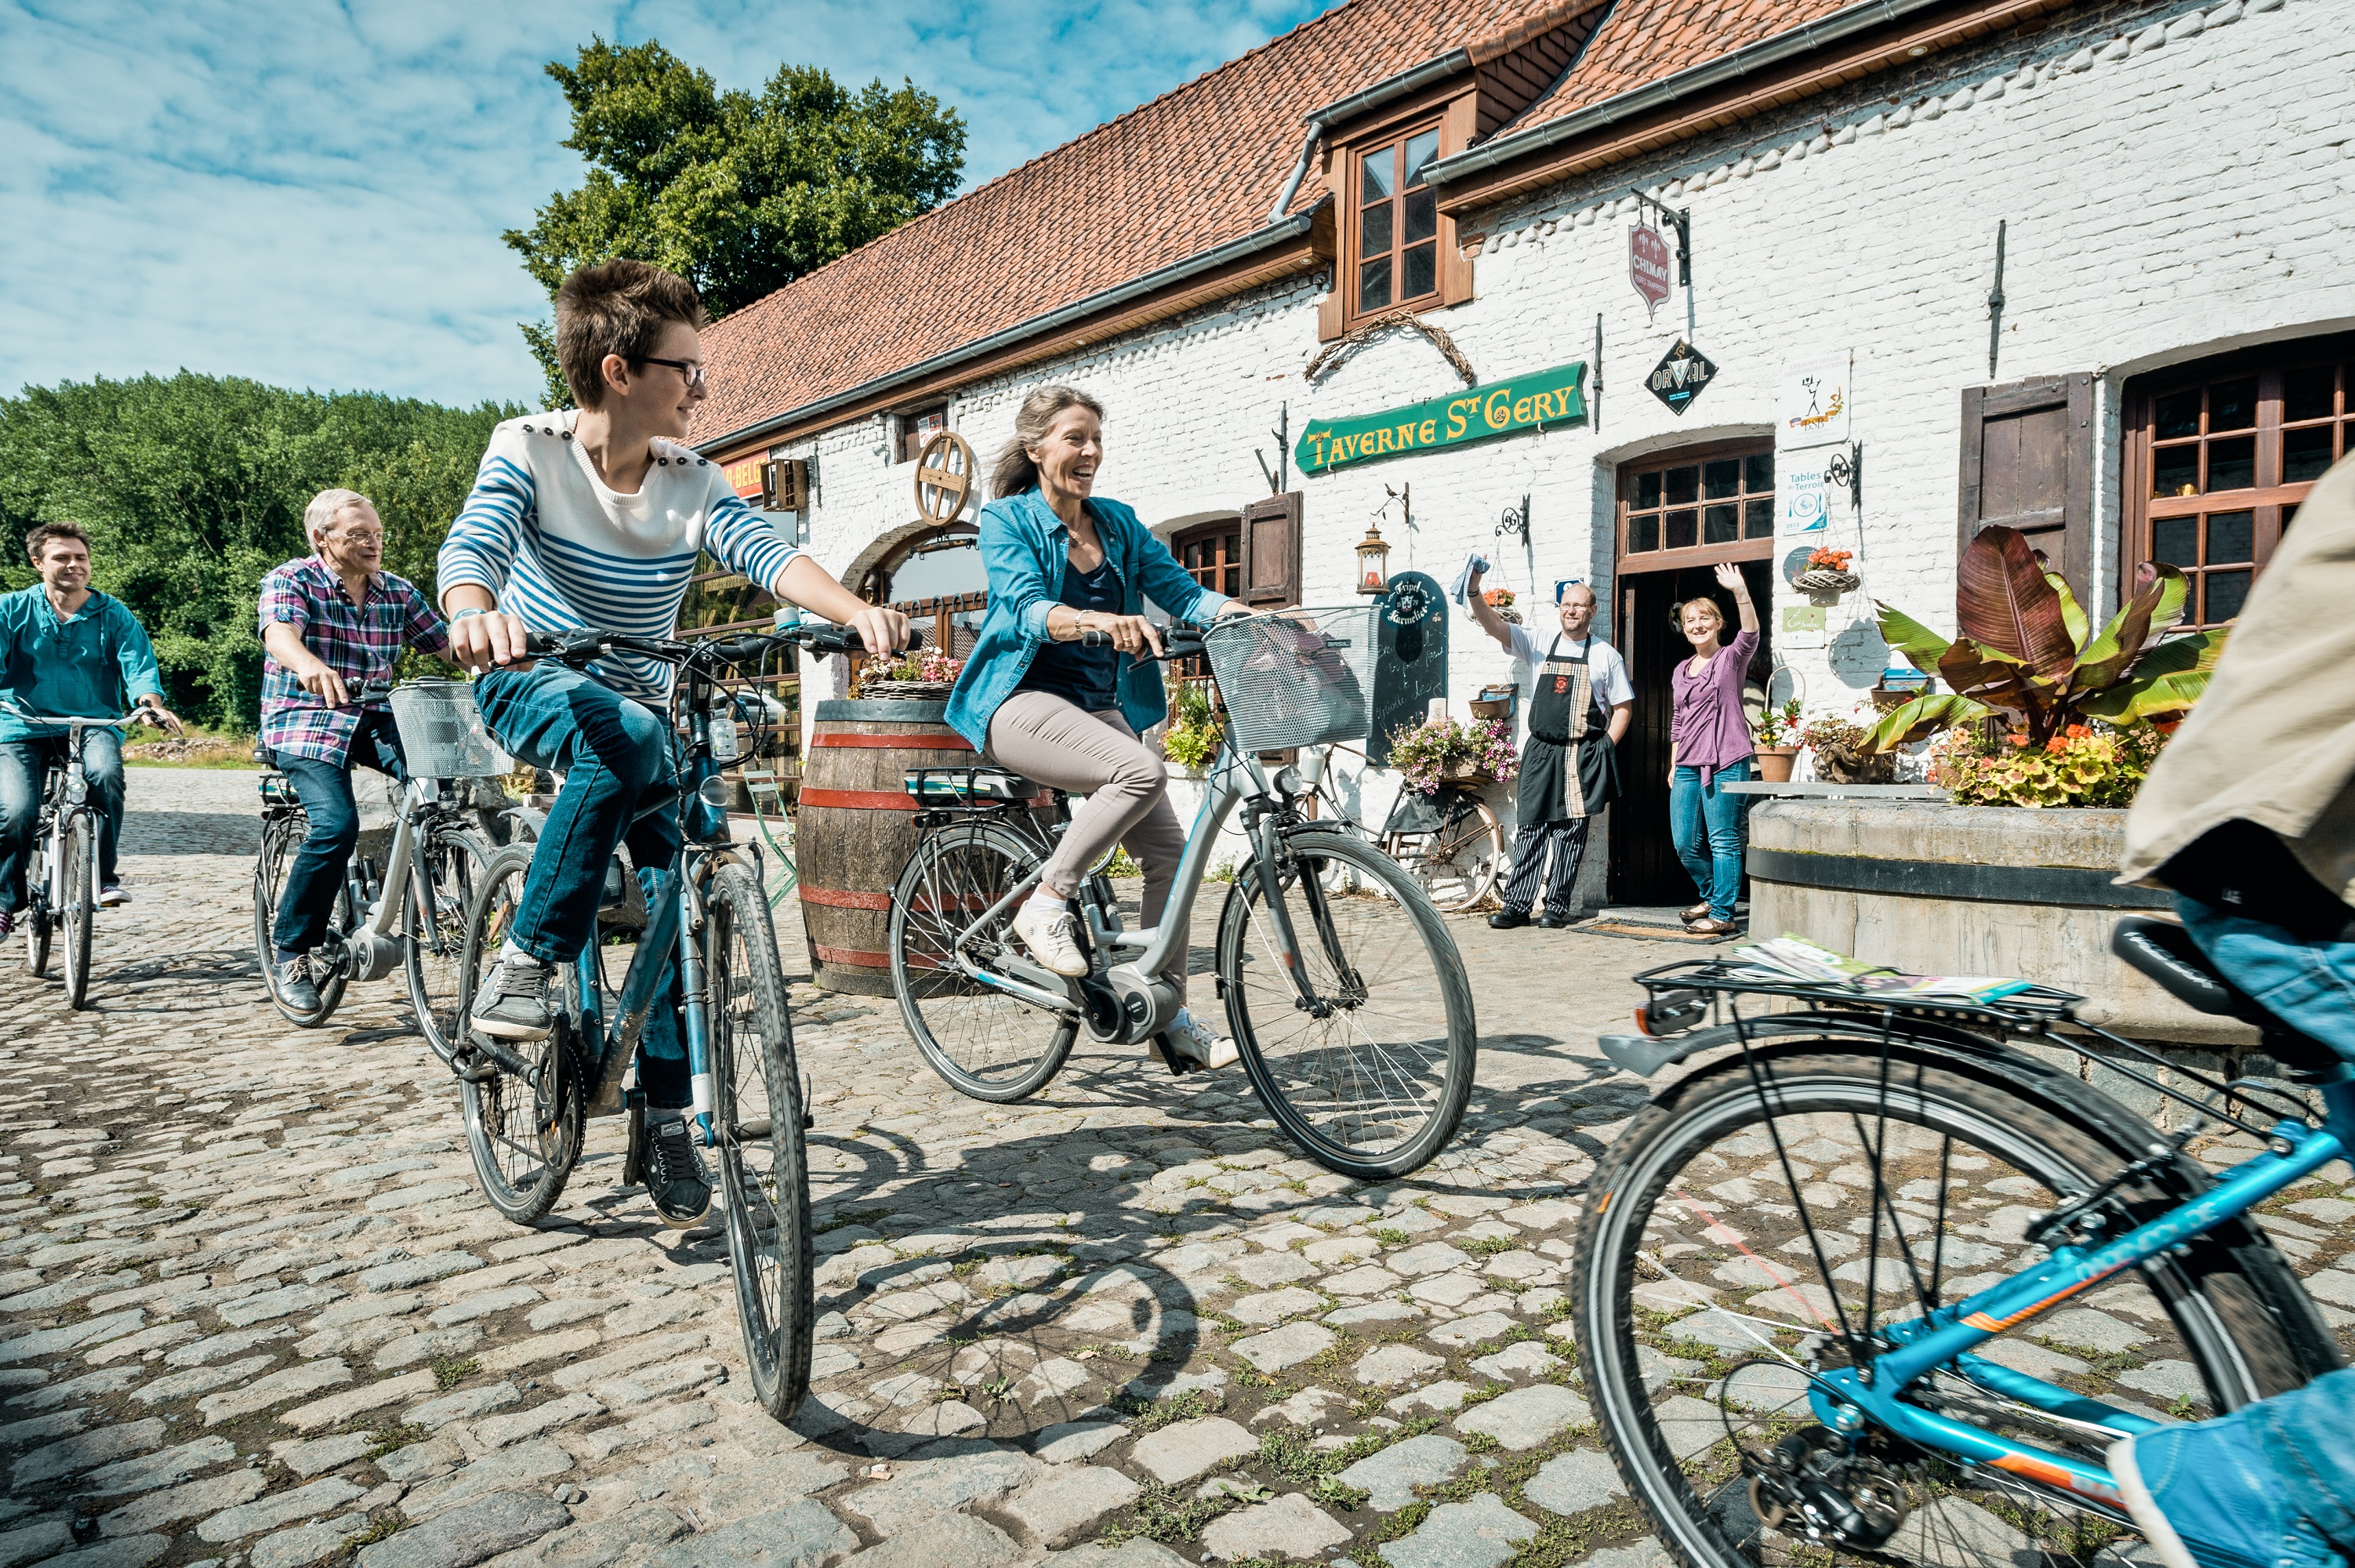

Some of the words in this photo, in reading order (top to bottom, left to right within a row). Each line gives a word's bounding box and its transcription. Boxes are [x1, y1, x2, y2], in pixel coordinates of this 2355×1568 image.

[1633, 254, 1667, 281] CHIMAY
[1653, 355, 1709, 390] ORVAL
[1307, 419, 1438, 466] TAVERNE
[1484, 386, 1575, 429] GERY
[1805, 417, 1824, 431] BSB
[1790, 471, 1821, 483] Tables
[1795, 480, 1824, 491] Terroir
[1395, 579, 1422, 596] Tripel
[1387, 605, 1428, 625] Karmeliet
